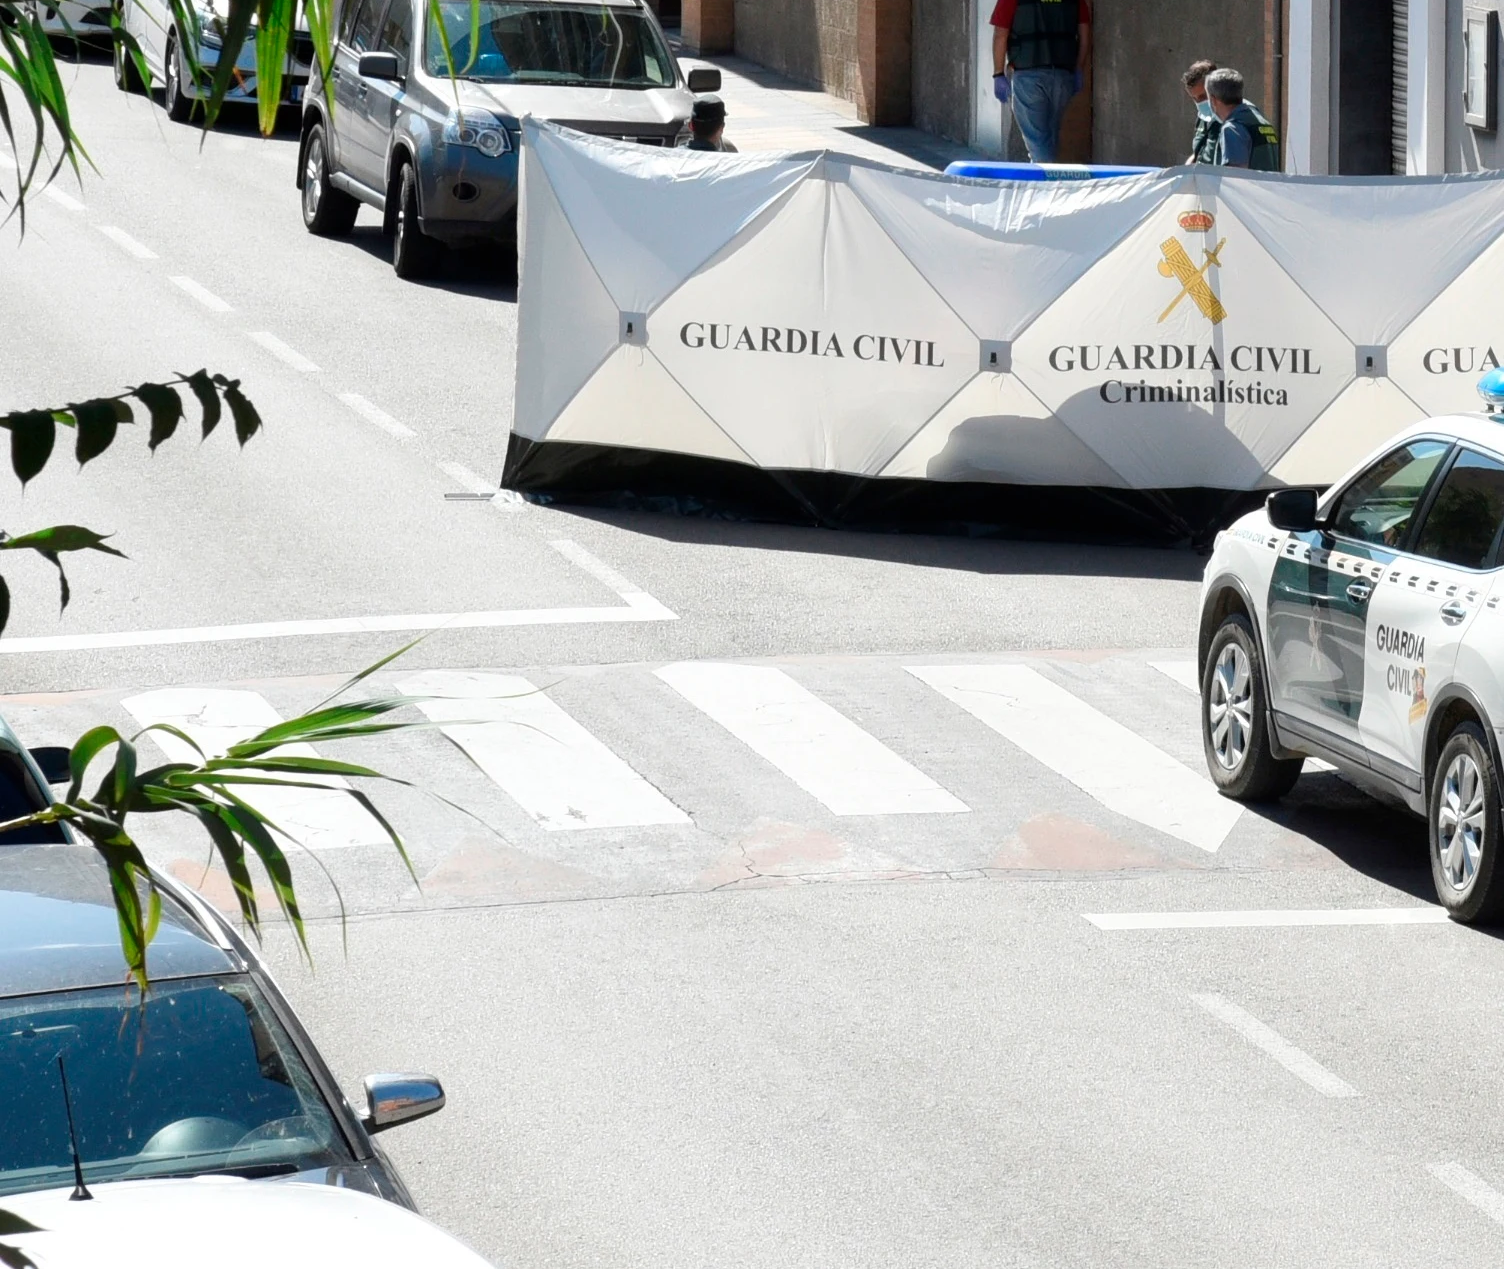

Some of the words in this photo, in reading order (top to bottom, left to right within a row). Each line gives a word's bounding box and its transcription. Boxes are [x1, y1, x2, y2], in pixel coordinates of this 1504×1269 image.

[1045, 171, 1091, 179] GUARDIA
[680, 321, 845, 358] GUARDIA
[853, 334, 945, 368] CIVIL
[1049, 344, 1222, 371] GUARDIA
[1231, 345, 1321, 374] CIVIL
[1100, 379, 1287, 406] Criminalística
[1377, 624, 1425, 663] GUARDIA
[1387, 664, 1411, 696] CIVIL
